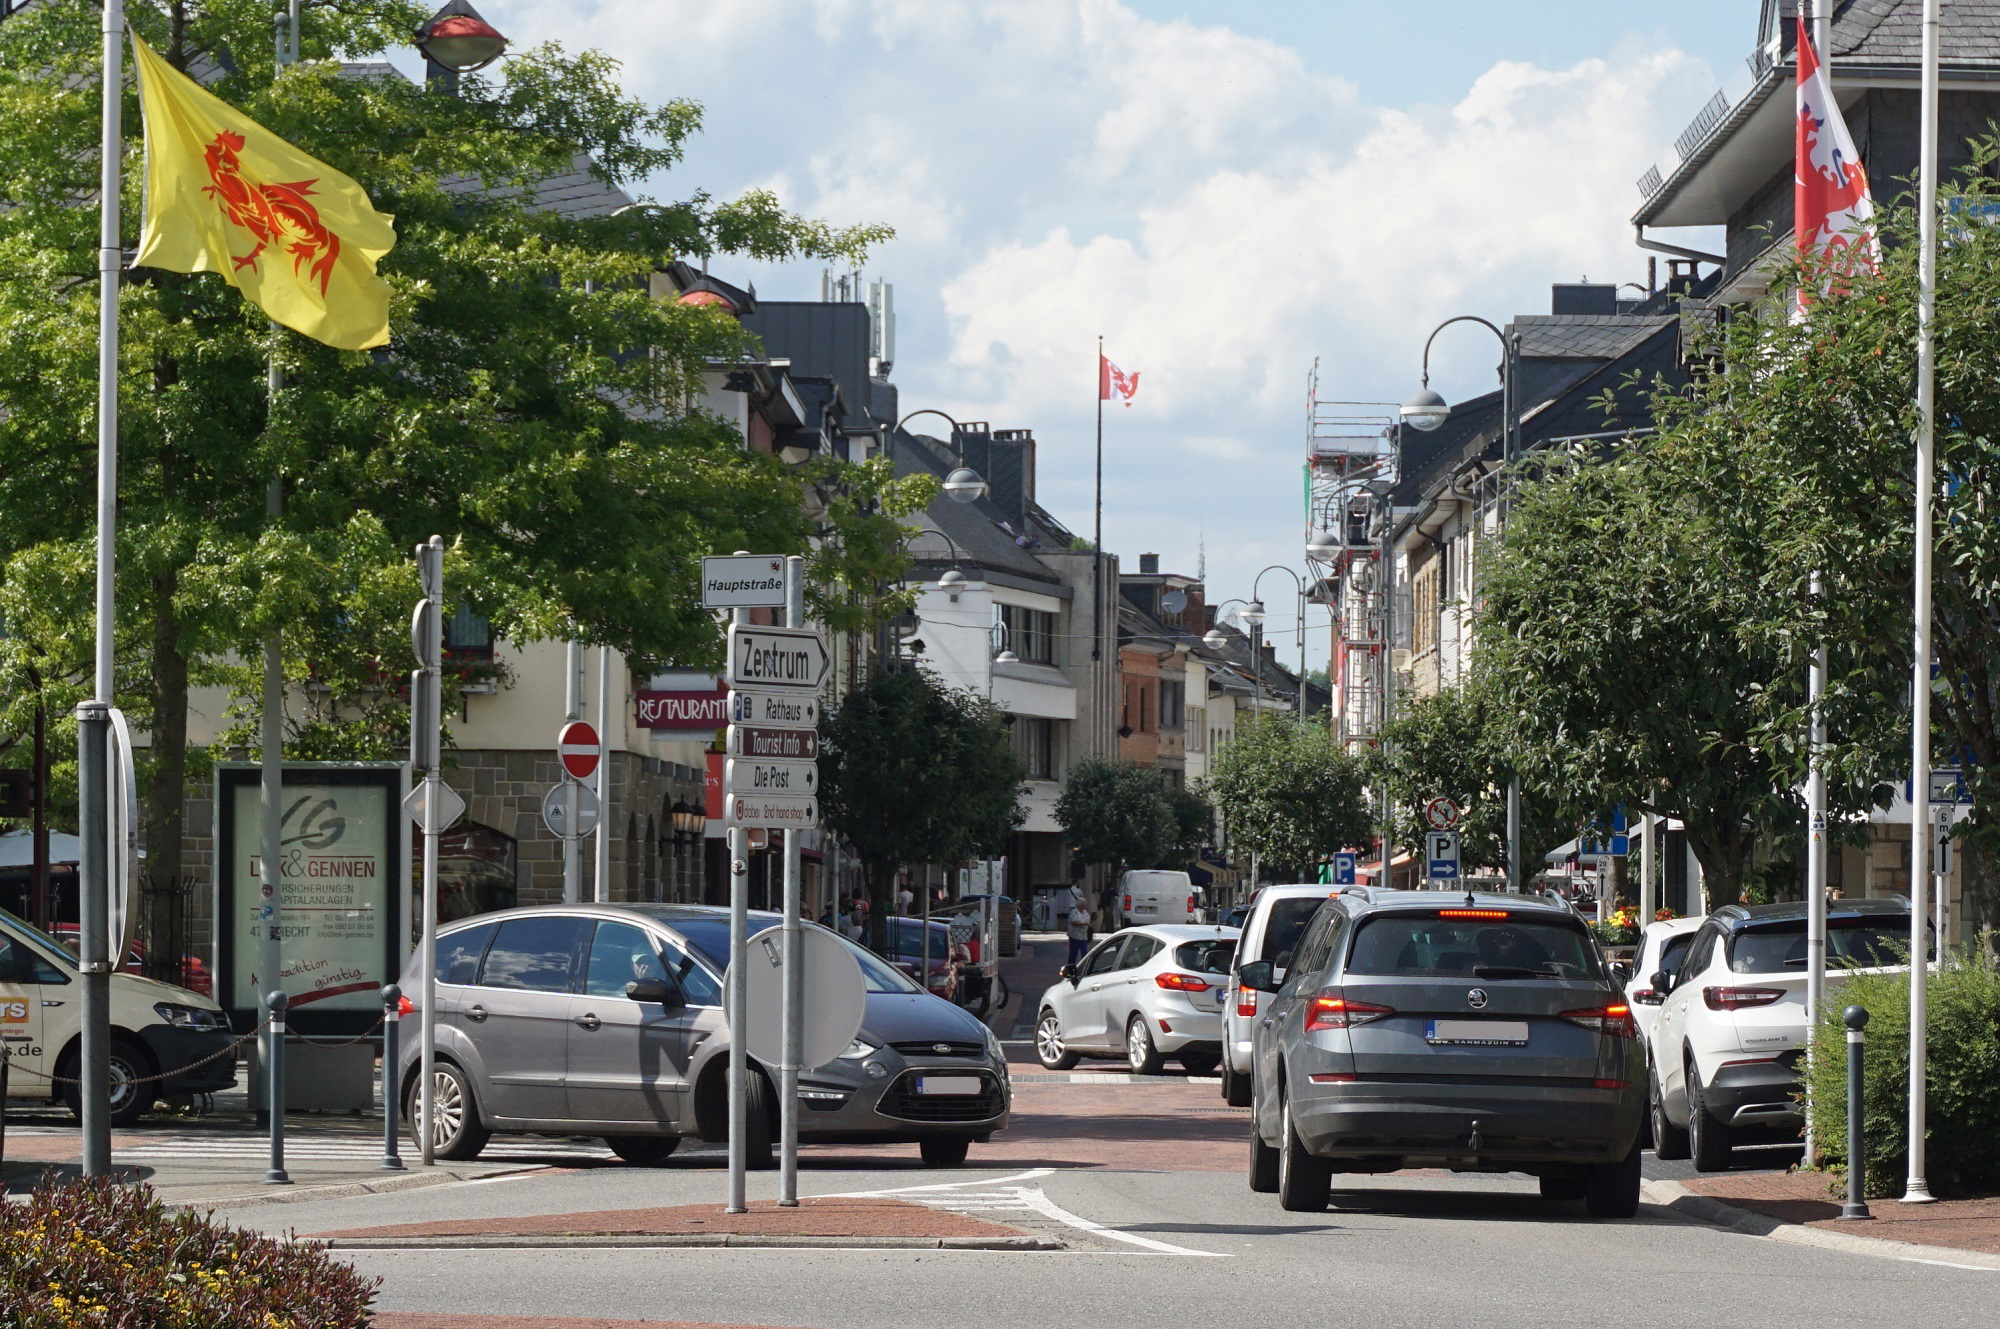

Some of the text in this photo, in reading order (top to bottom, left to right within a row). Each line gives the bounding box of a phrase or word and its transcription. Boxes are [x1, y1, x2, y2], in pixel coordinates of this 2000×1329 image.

[707, 578, 782, 593] Hauptstraße
[743, 637, 809, 680] Zentrum
[639, 699, 728, 722] RESTAURANT
[765, 697, 801, 721] Rathaus
[752, 731, 782, 754] Tourist
[783, 732, 800, 755] Info
[754, 765, 790, 788] Die Post
[776, 804, 789, 820] hand
[790, 804, 804, 823] shop
[1941, 812, 1947, 823] 6
[1939, 825, 1949, 833] m
[1436, 838, 1451, 859] P
[308, 860, 375, 878] GENNEN
[1336, 857, 1352, 880] P
[281, 883, 354, 893] RSICHERUNGEN
[280, 895, 353, 905] APITALANLAGEN
